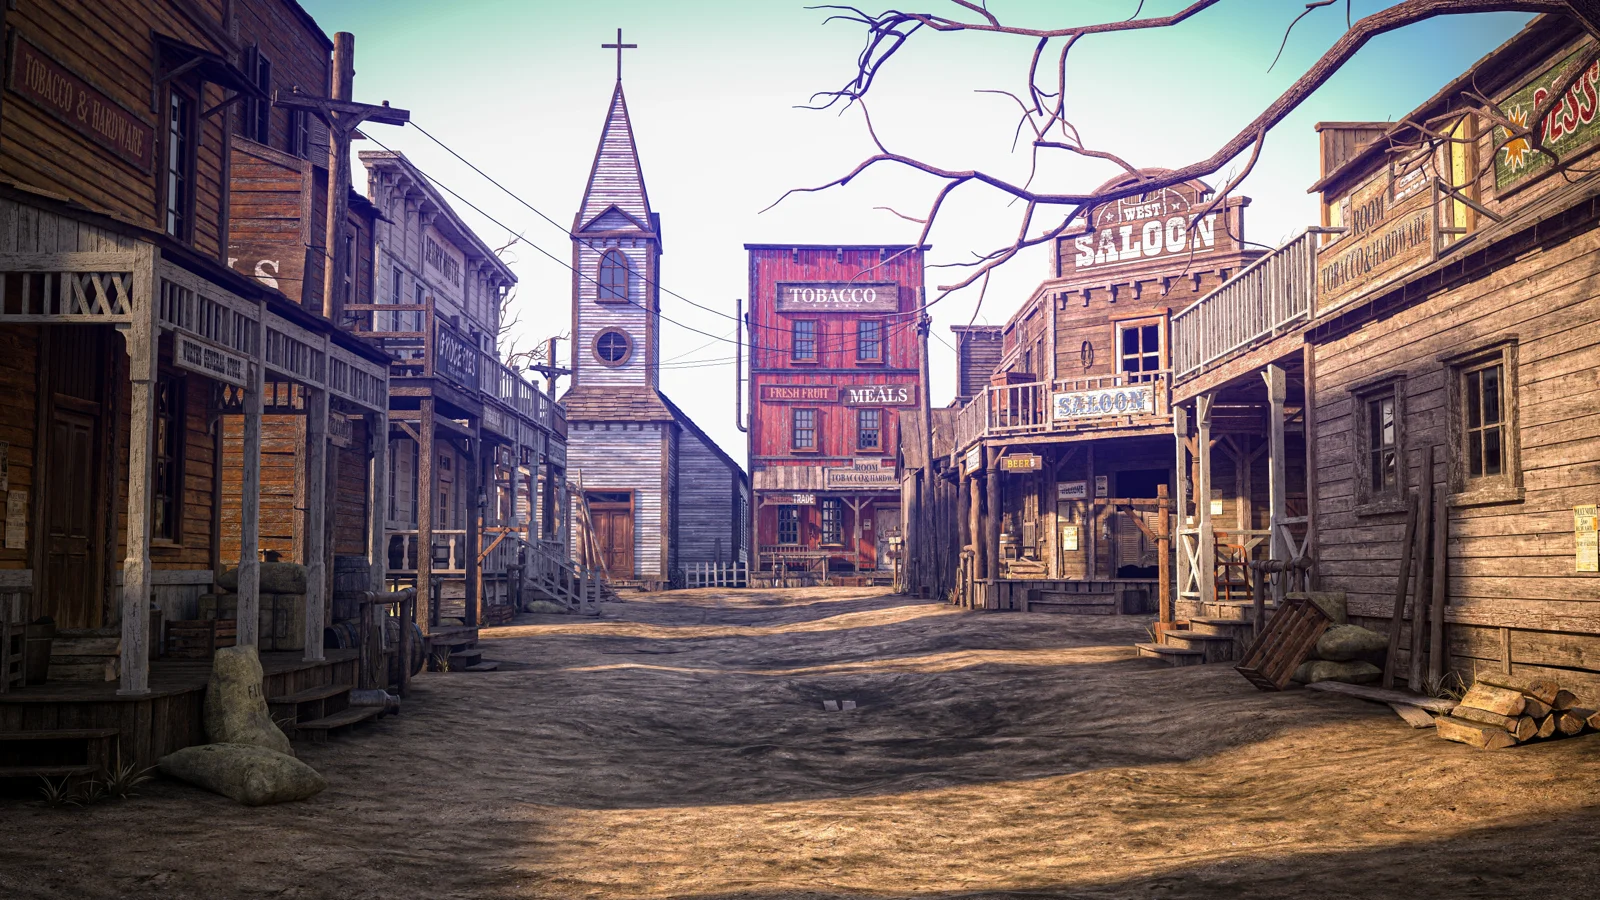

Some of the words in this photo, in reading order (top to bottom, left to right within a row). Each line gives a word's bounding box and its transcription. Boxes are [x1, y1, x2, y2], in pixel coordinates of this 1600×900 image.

[25, 53, 72, 118] TOBACCO
[76, 91, 89, 122] &
[92, 104, 144, 159] HARDWARE
[1124, 203, 1160, 221] WEST
[1353, 196, 1384, 236] ROOM
[1076, 212, 1216, 268] SALOON
[790, 288, 876, 303] TOBACCO
[439, 332, 476, 377] GROCERIES
[770, 388, 799, 399] FRESH
[801, 387, 829, 399] FRUIT
[850, 388, 908, 403] MEALS
[1059, 390, 1146, 416] SALOON
[1007, 459, 1030, 468] BEER
[793, 494, 814, 504] TRADE
